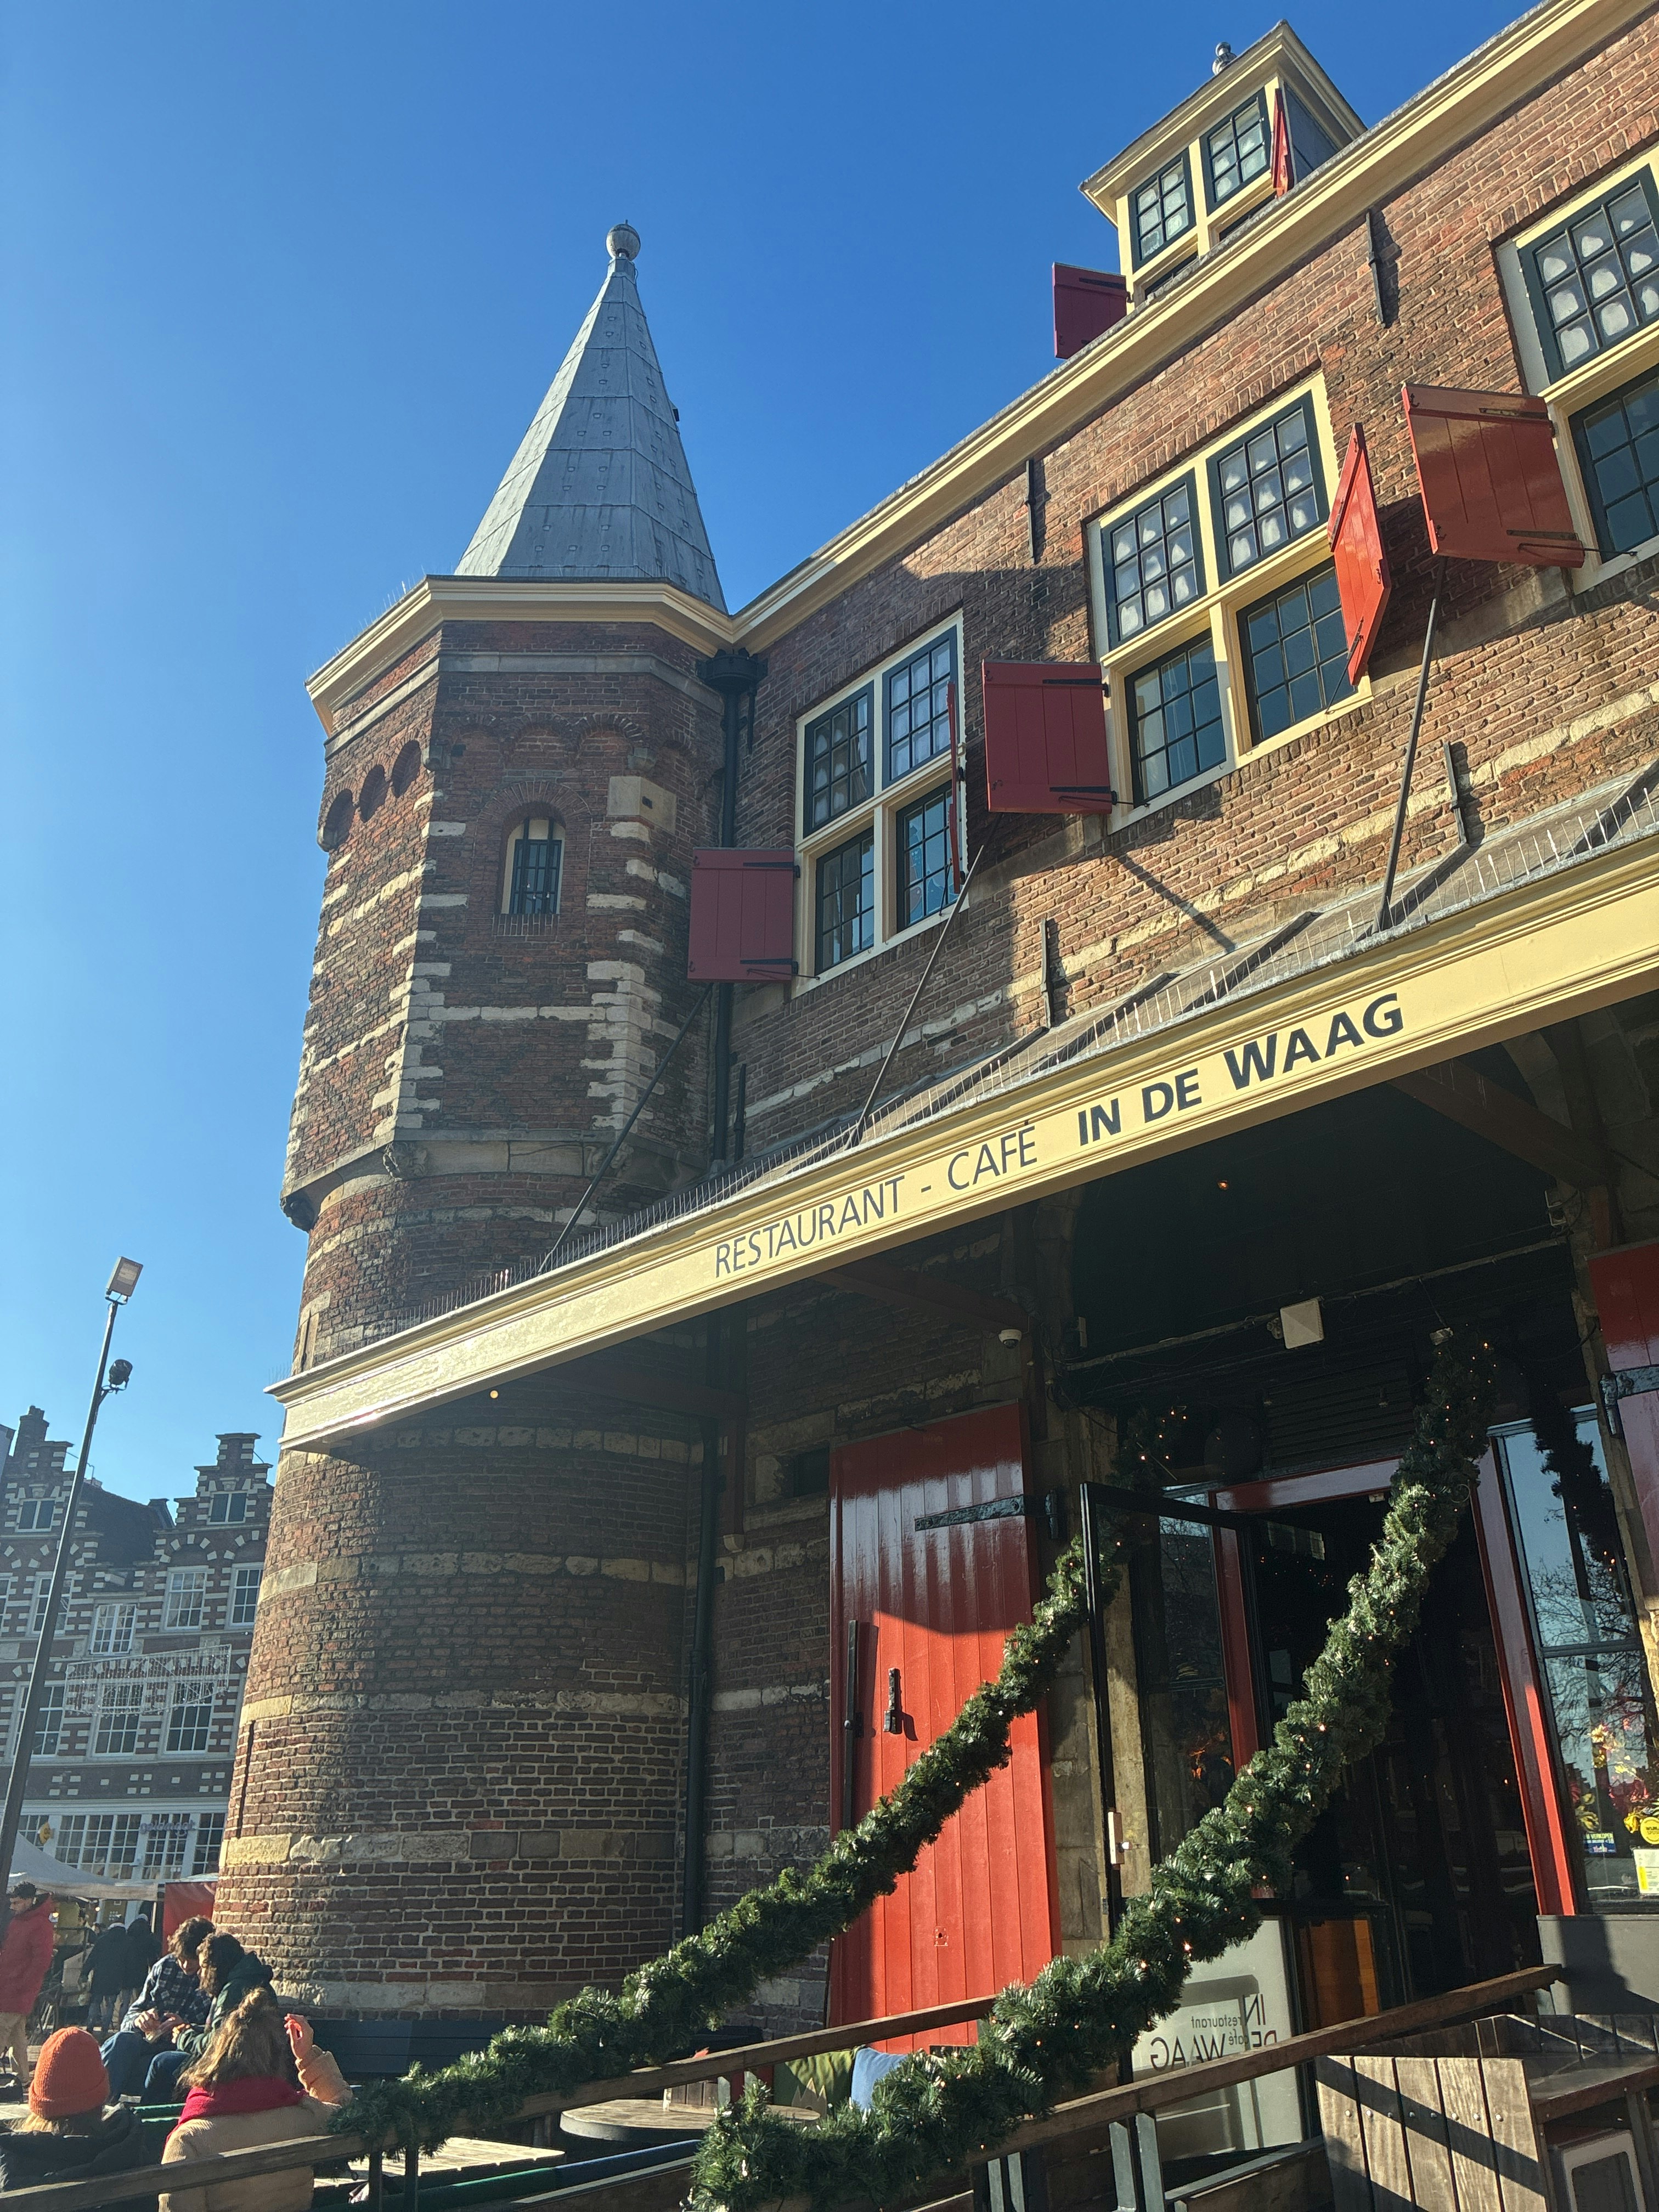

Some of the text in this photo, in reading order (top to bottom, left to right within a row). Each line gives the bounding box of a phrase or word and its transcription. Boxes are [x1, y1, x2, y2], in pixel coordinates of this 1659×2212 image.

[715, 1175, 905, 1278] RESTAURANT
[947, 1120, 1037, 1190] CAFÉ
[1077, 1098, 1121, 1147] IN
[1141, 1068, 1203, 1124] DE
[1222, 992, 1404, 1091] WAAG
